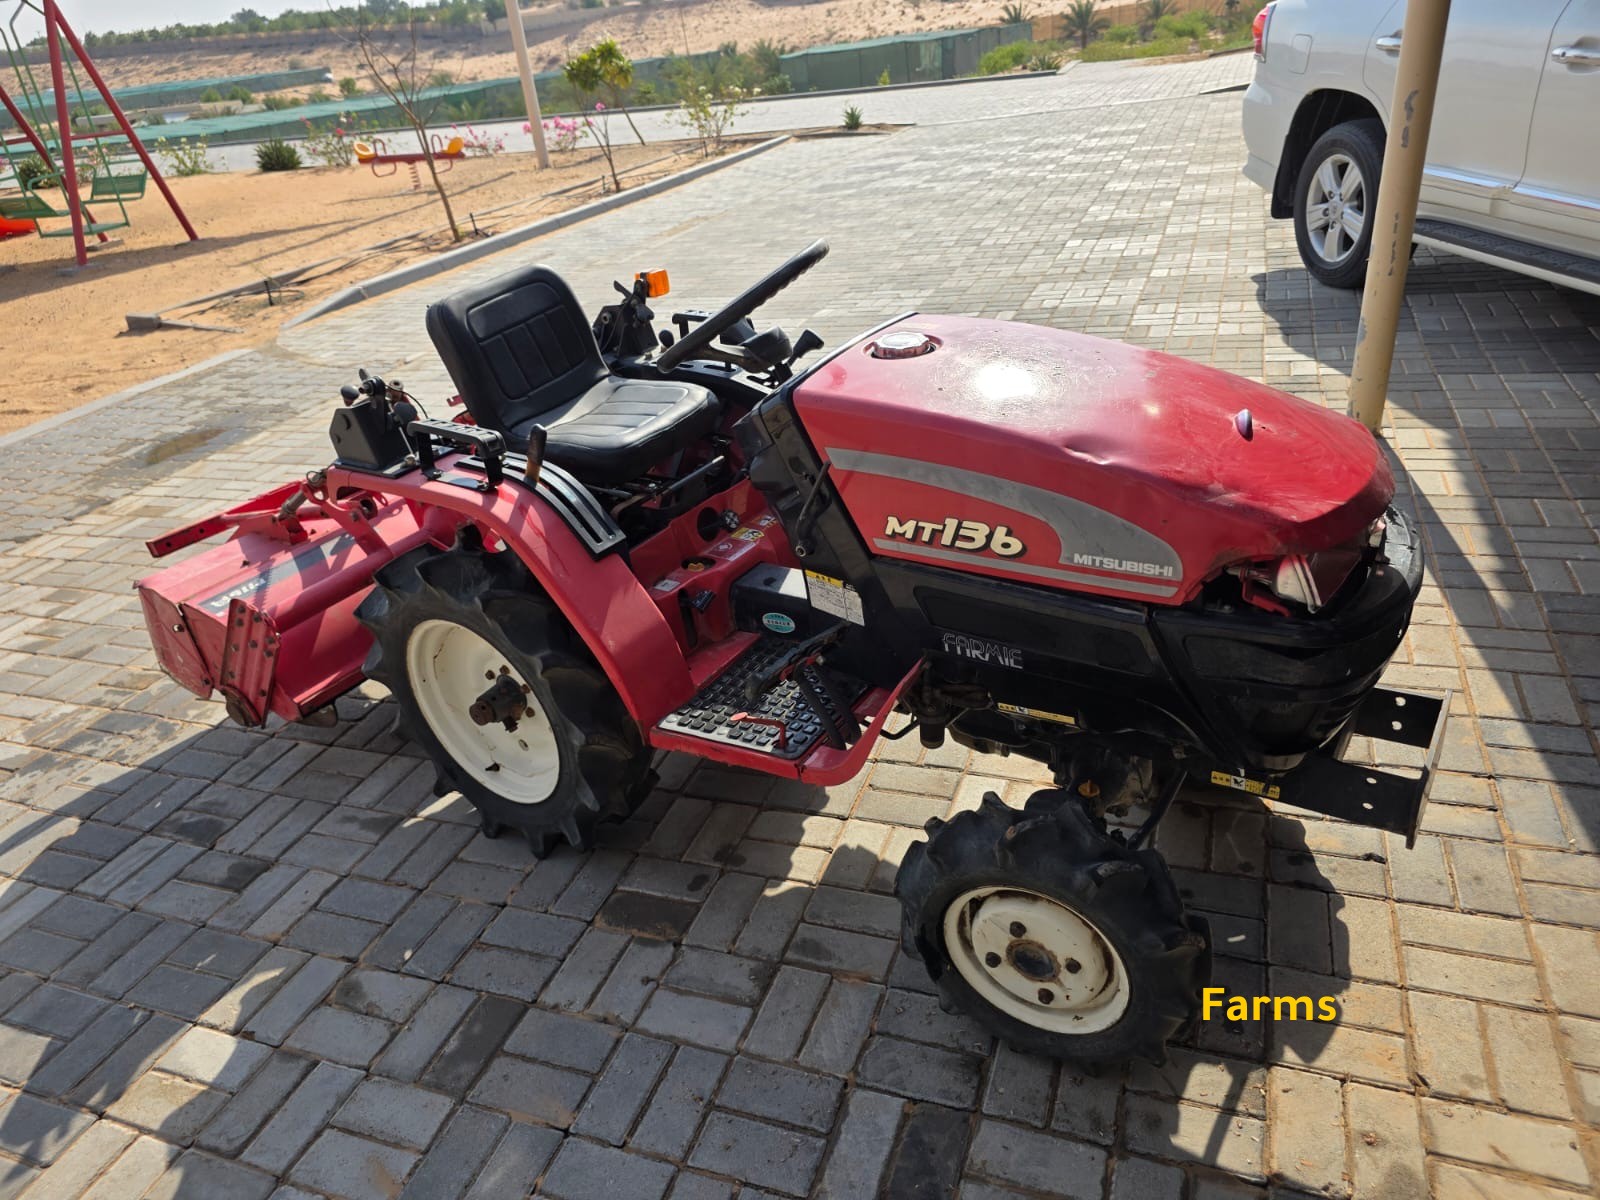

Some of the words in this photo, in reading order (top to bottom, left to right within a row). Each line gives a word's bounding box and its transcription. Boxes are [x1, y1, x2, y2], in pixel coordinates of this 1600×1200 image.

[885, 516, 1025, 557] MT136
[1073, 553, 1174, 577] MITSUBISHI
[943, 632, 1023, 669] FARMIE
